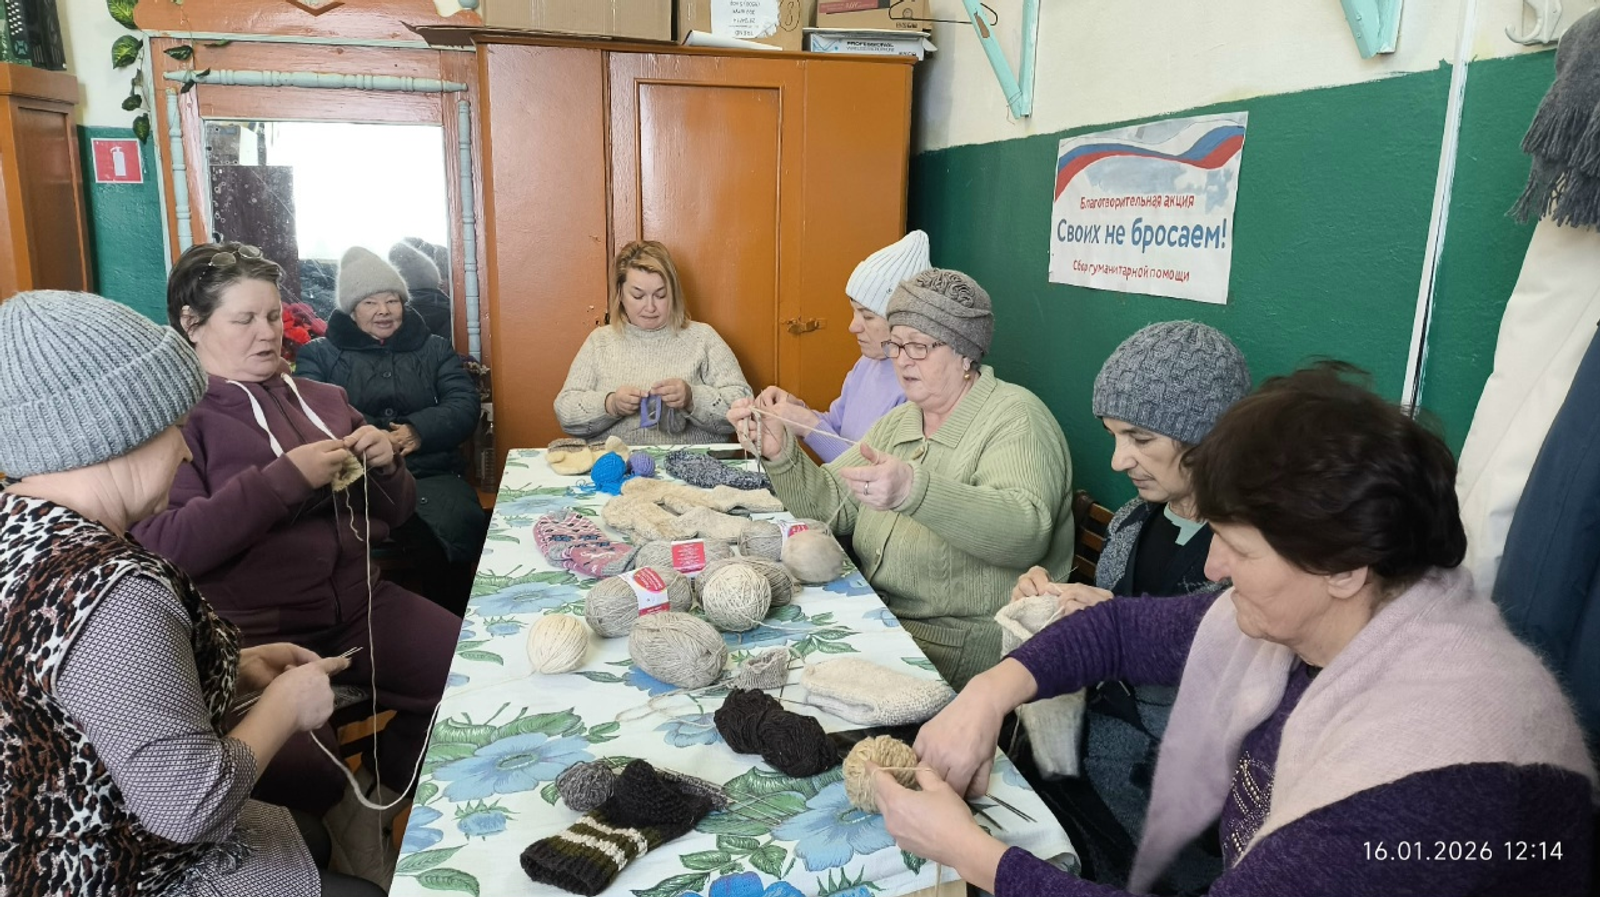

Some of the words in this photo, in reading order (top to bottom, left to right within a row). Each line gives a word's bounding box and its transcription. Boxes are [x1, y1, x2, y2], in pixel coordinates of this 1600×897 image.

[1080, 195, 1162, 210] Благотворительная
[1164, 195, 1195, 209] акция
[1057, 218, 1101, 244] Своих
[1104, 224, 1126, 246] не
[1131, 217, 1227, 253] бросаем!
[1073, 259, 1088, 272] Сбор
[1089, 263, 1149, 280] гуманитарной
[1150, 269, 1190, 283] помощи
